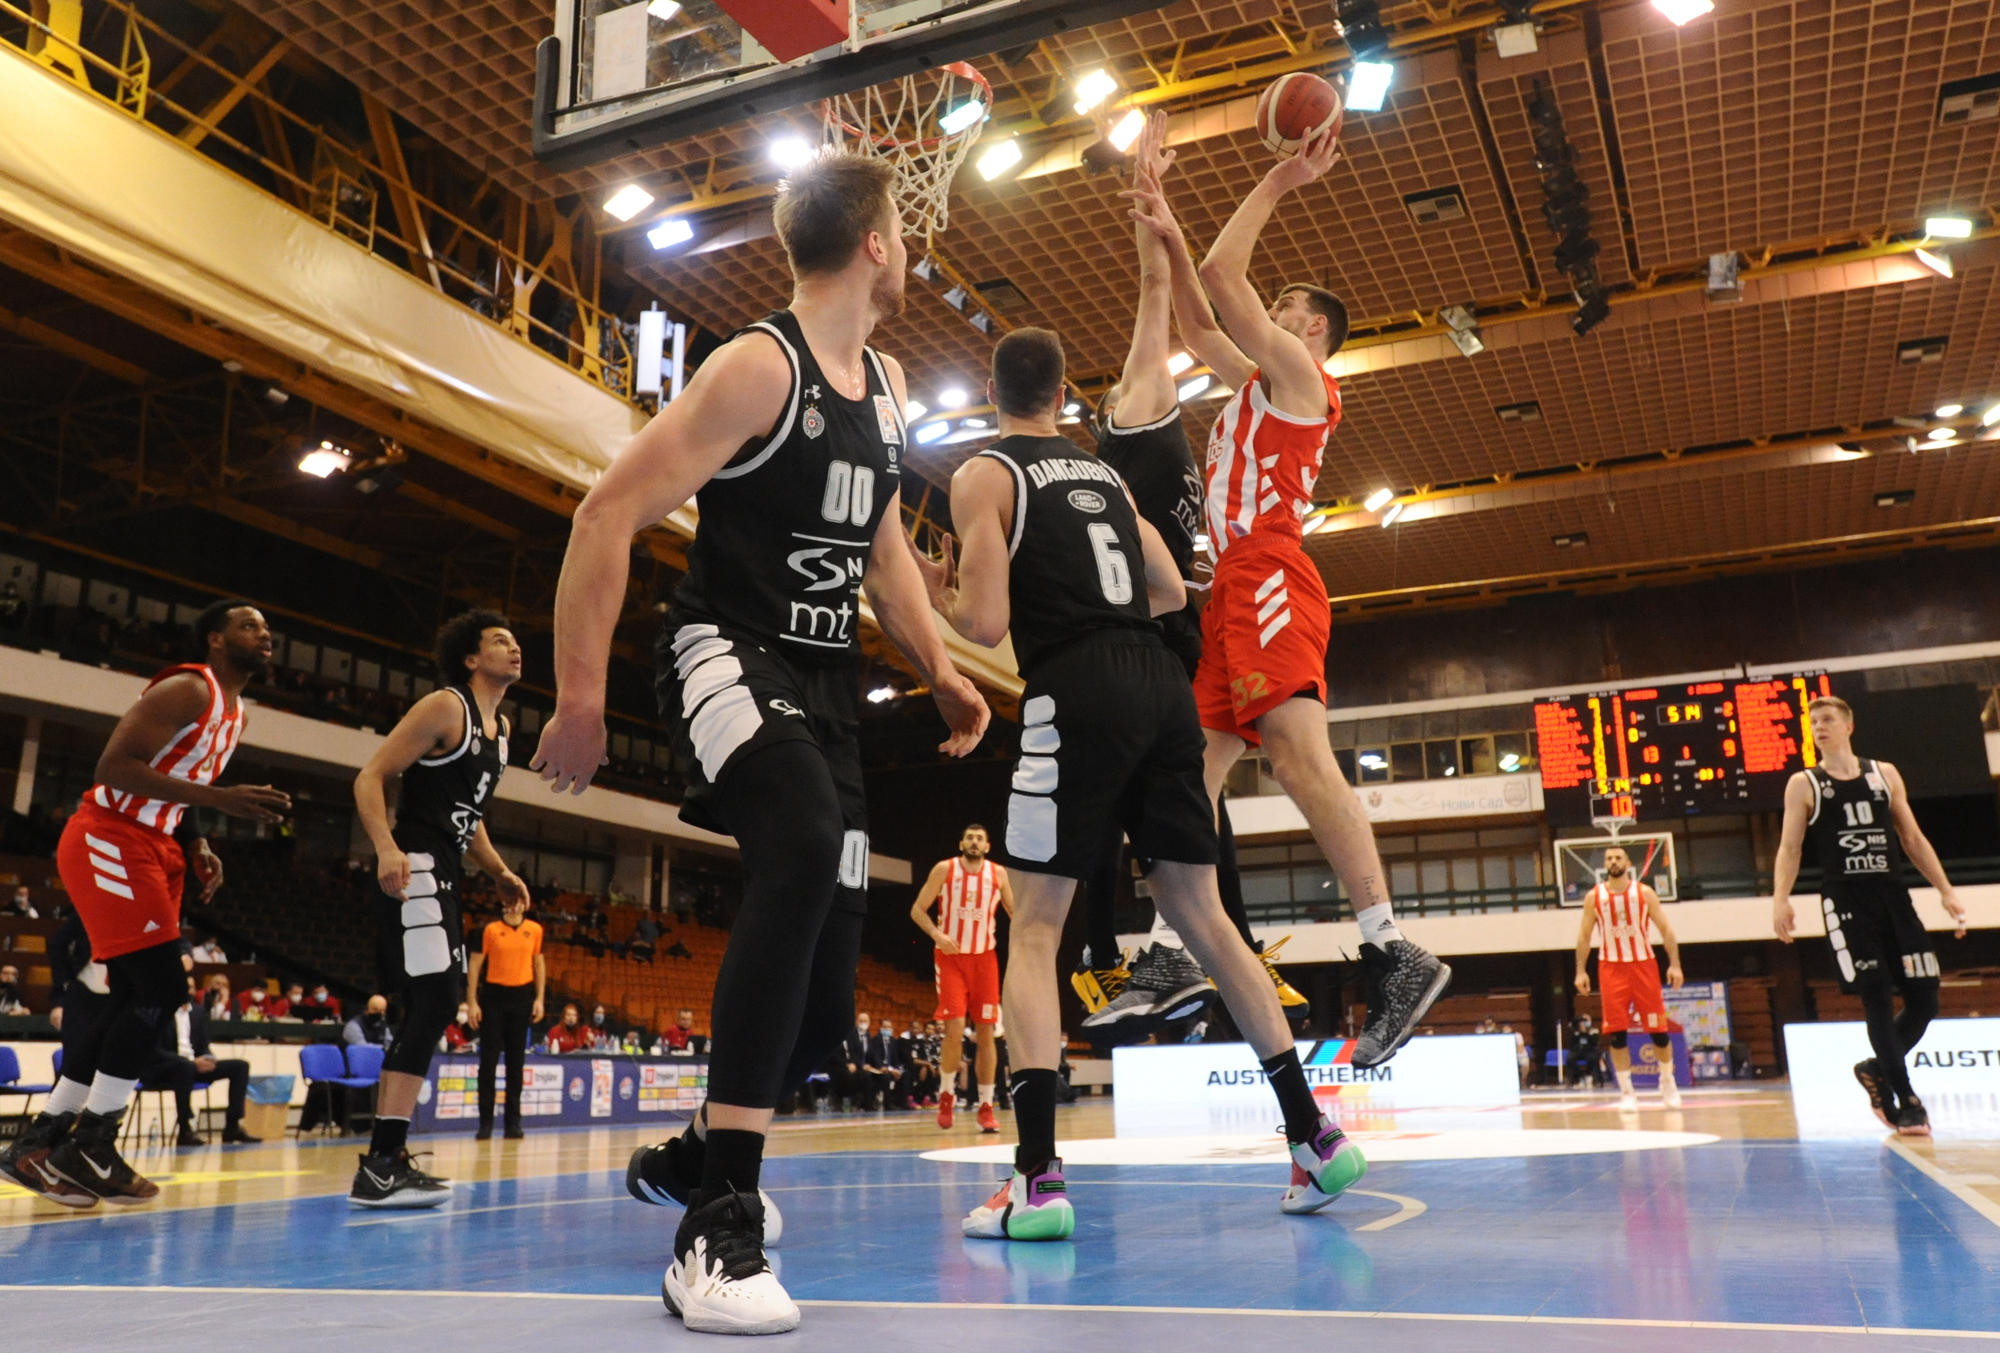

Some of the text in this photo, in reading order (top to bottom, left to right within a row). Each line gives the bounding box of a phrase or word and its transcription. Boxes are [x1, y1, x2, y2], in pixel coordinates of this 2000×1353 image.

[821, 460, 875, 527] 00
[1087, 522, 1133, 605] 6
[790, 601, 853, 640] mt
[1230, 672, 1269, 708] 32
[1643, 745, 1660, 763] 13
[1723, 739, 1736, 757] 9
[474, 771, 491, 804] 5
[1441, 797, 1504, 811] Нови Сад
[1612, 796, 1633, 818] 10
[1843, 801, 1874, 827] 10
[1867, 834, 1887, 845] NIS
[1846, 853, 1888, 870] mts
[1913, 1050, 2000, 1068] AUST
[1207, 1066, 1392, 1086] AUSTTHERM
